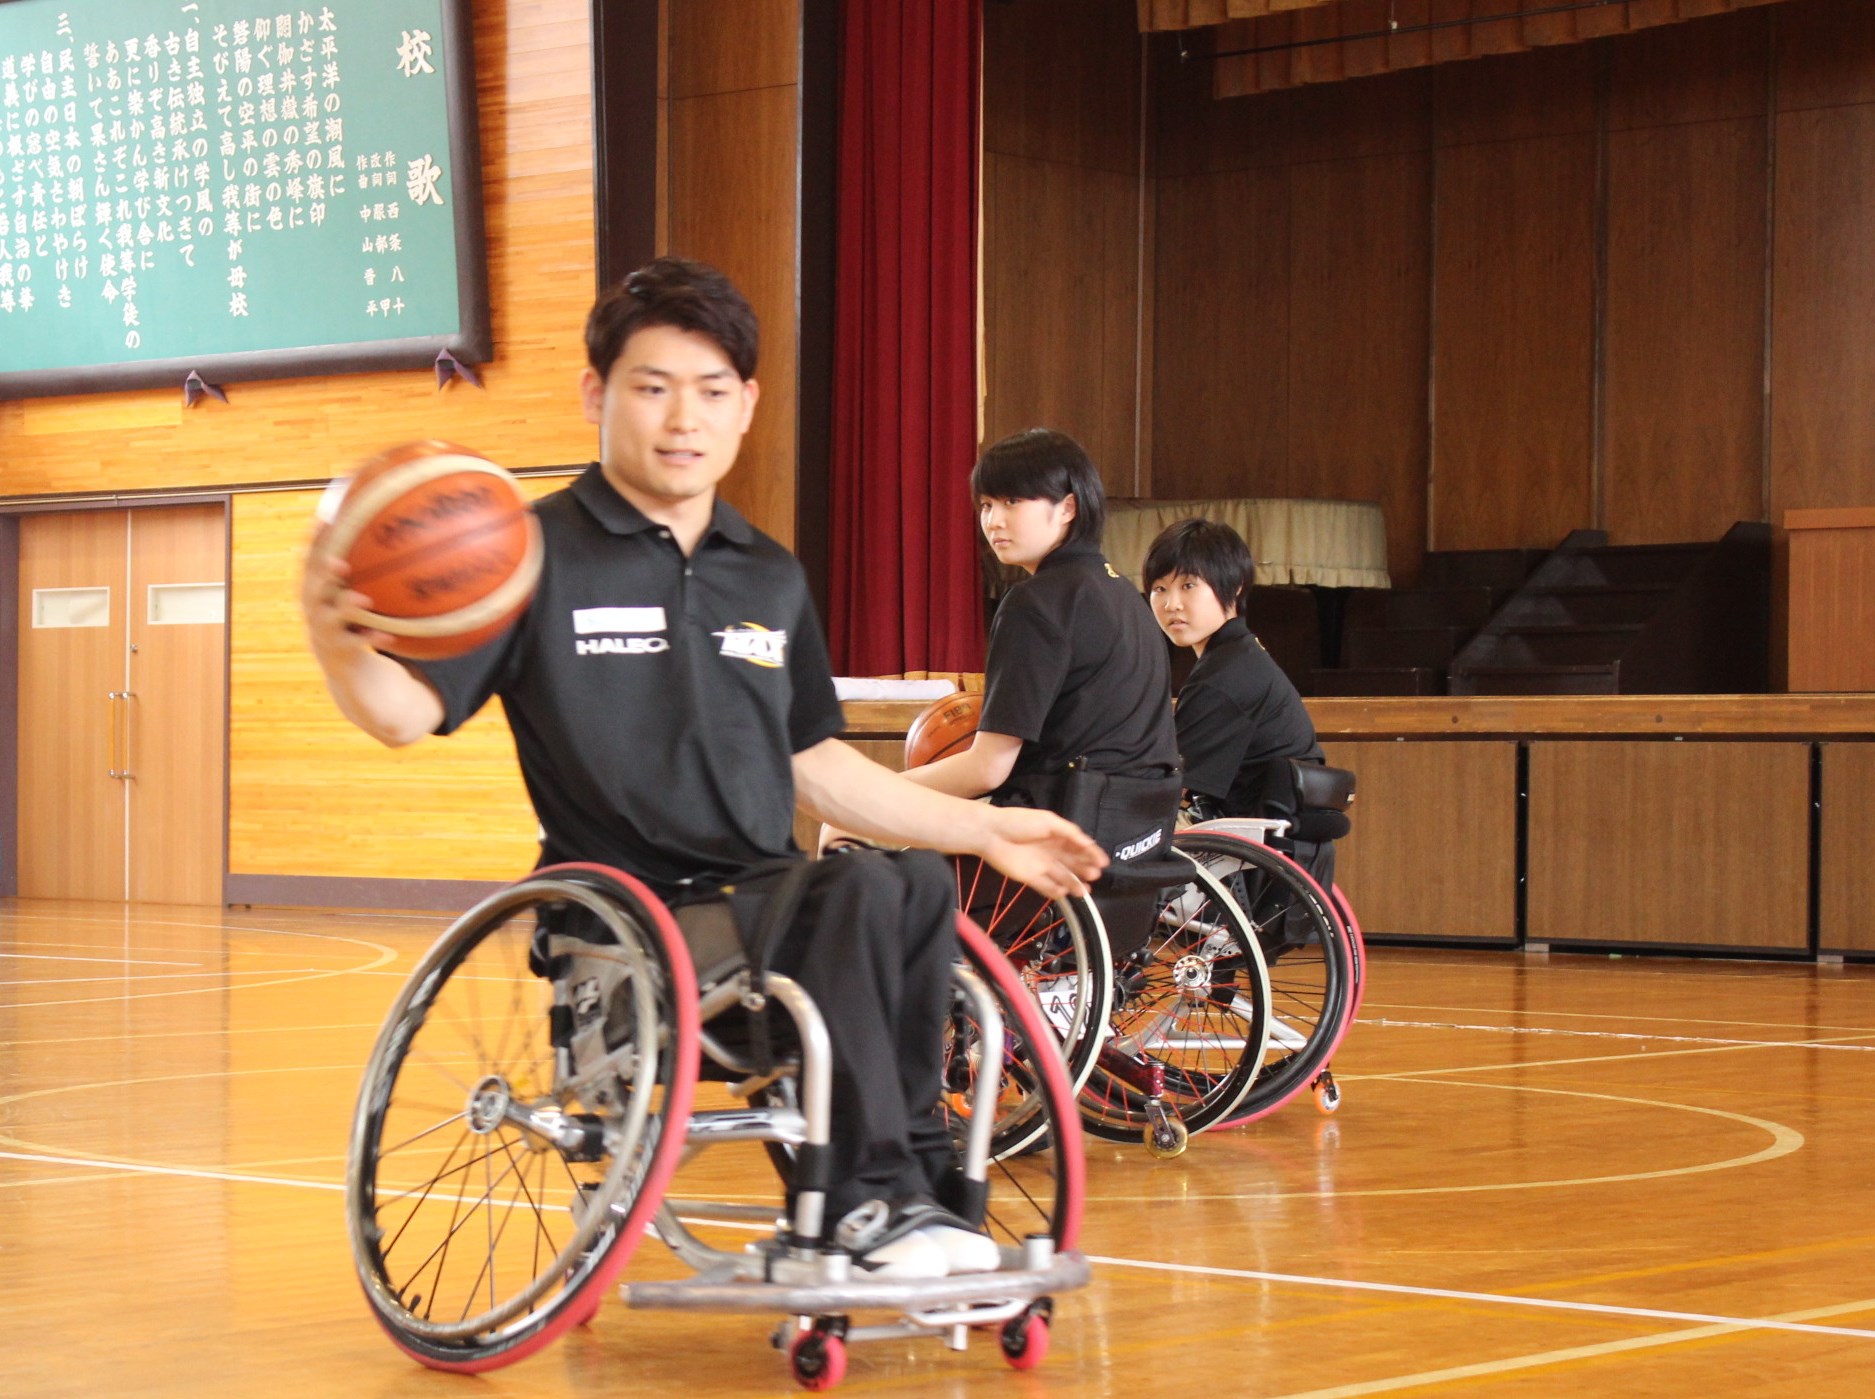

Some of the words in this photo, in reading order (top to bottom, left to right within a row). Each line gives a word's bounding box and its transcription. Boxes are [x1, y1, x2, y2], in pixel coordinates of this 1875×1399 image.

[318, 7, 346, 197] 太平洋の潮風に
